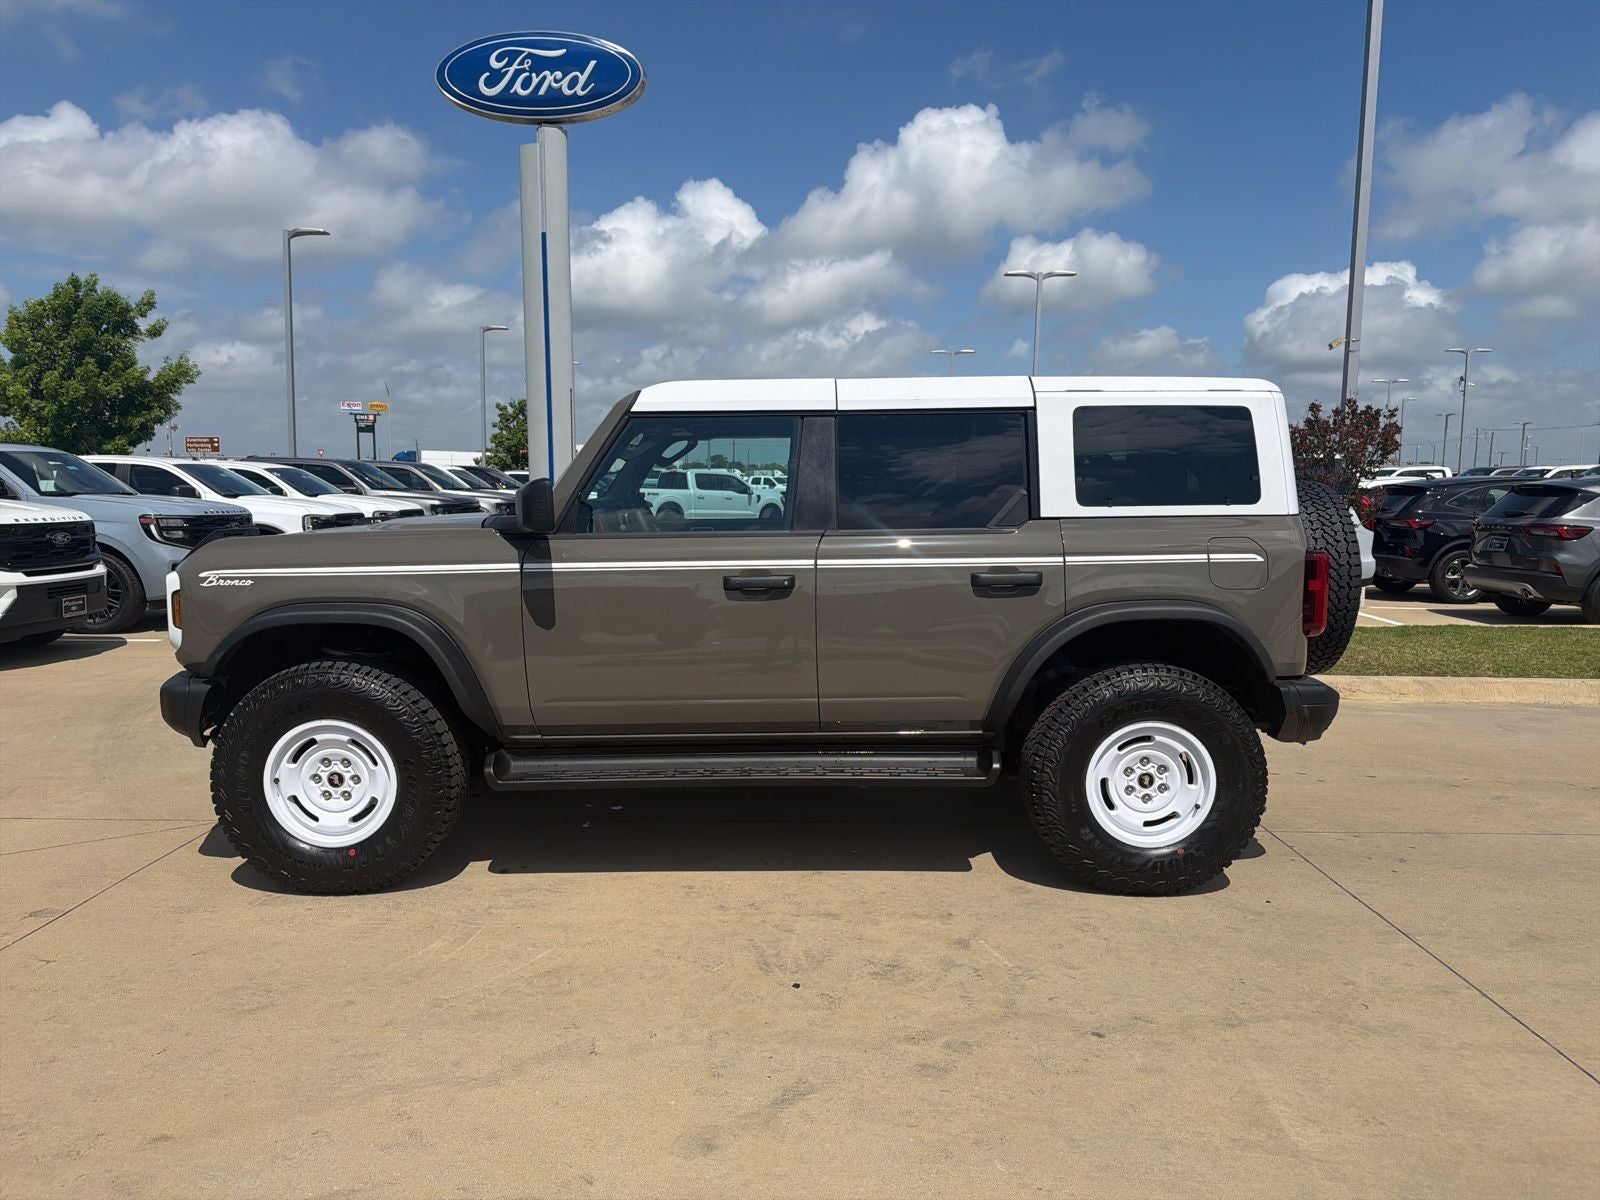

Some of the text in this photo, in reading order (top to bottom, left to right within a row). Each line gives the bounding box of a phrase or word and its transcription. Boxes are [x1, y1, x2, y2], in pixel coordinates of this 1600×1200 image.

[478, 46, 597, 97] Ford
[342, 401, 361, 409] Exxon
[200, 574, 254, 587] Bronco
